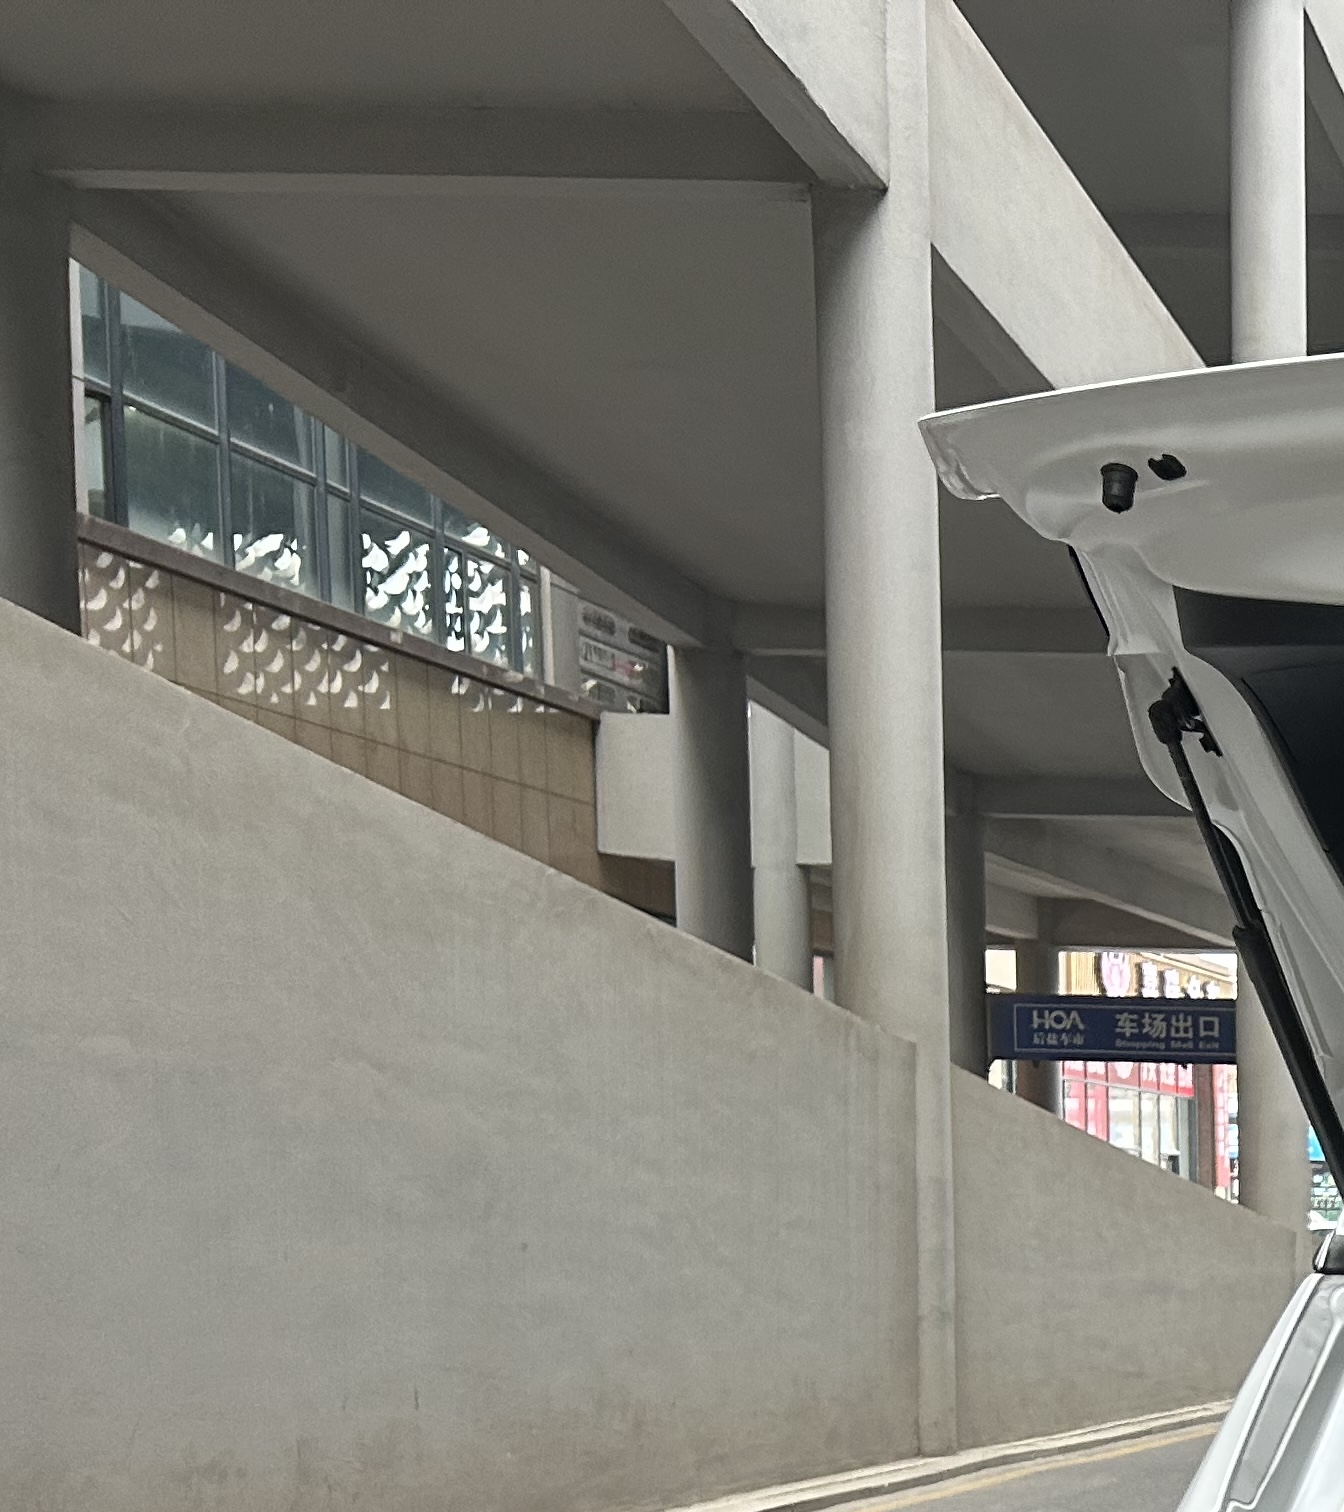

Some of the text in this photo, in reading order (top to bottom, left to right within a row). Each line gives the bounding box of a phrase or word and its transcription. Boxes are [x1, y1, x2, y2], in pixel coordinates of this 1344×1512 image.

[1032, 1010, 1085, 1031] HOA
[1115, 1012, 1220, 1040] 车场出口
